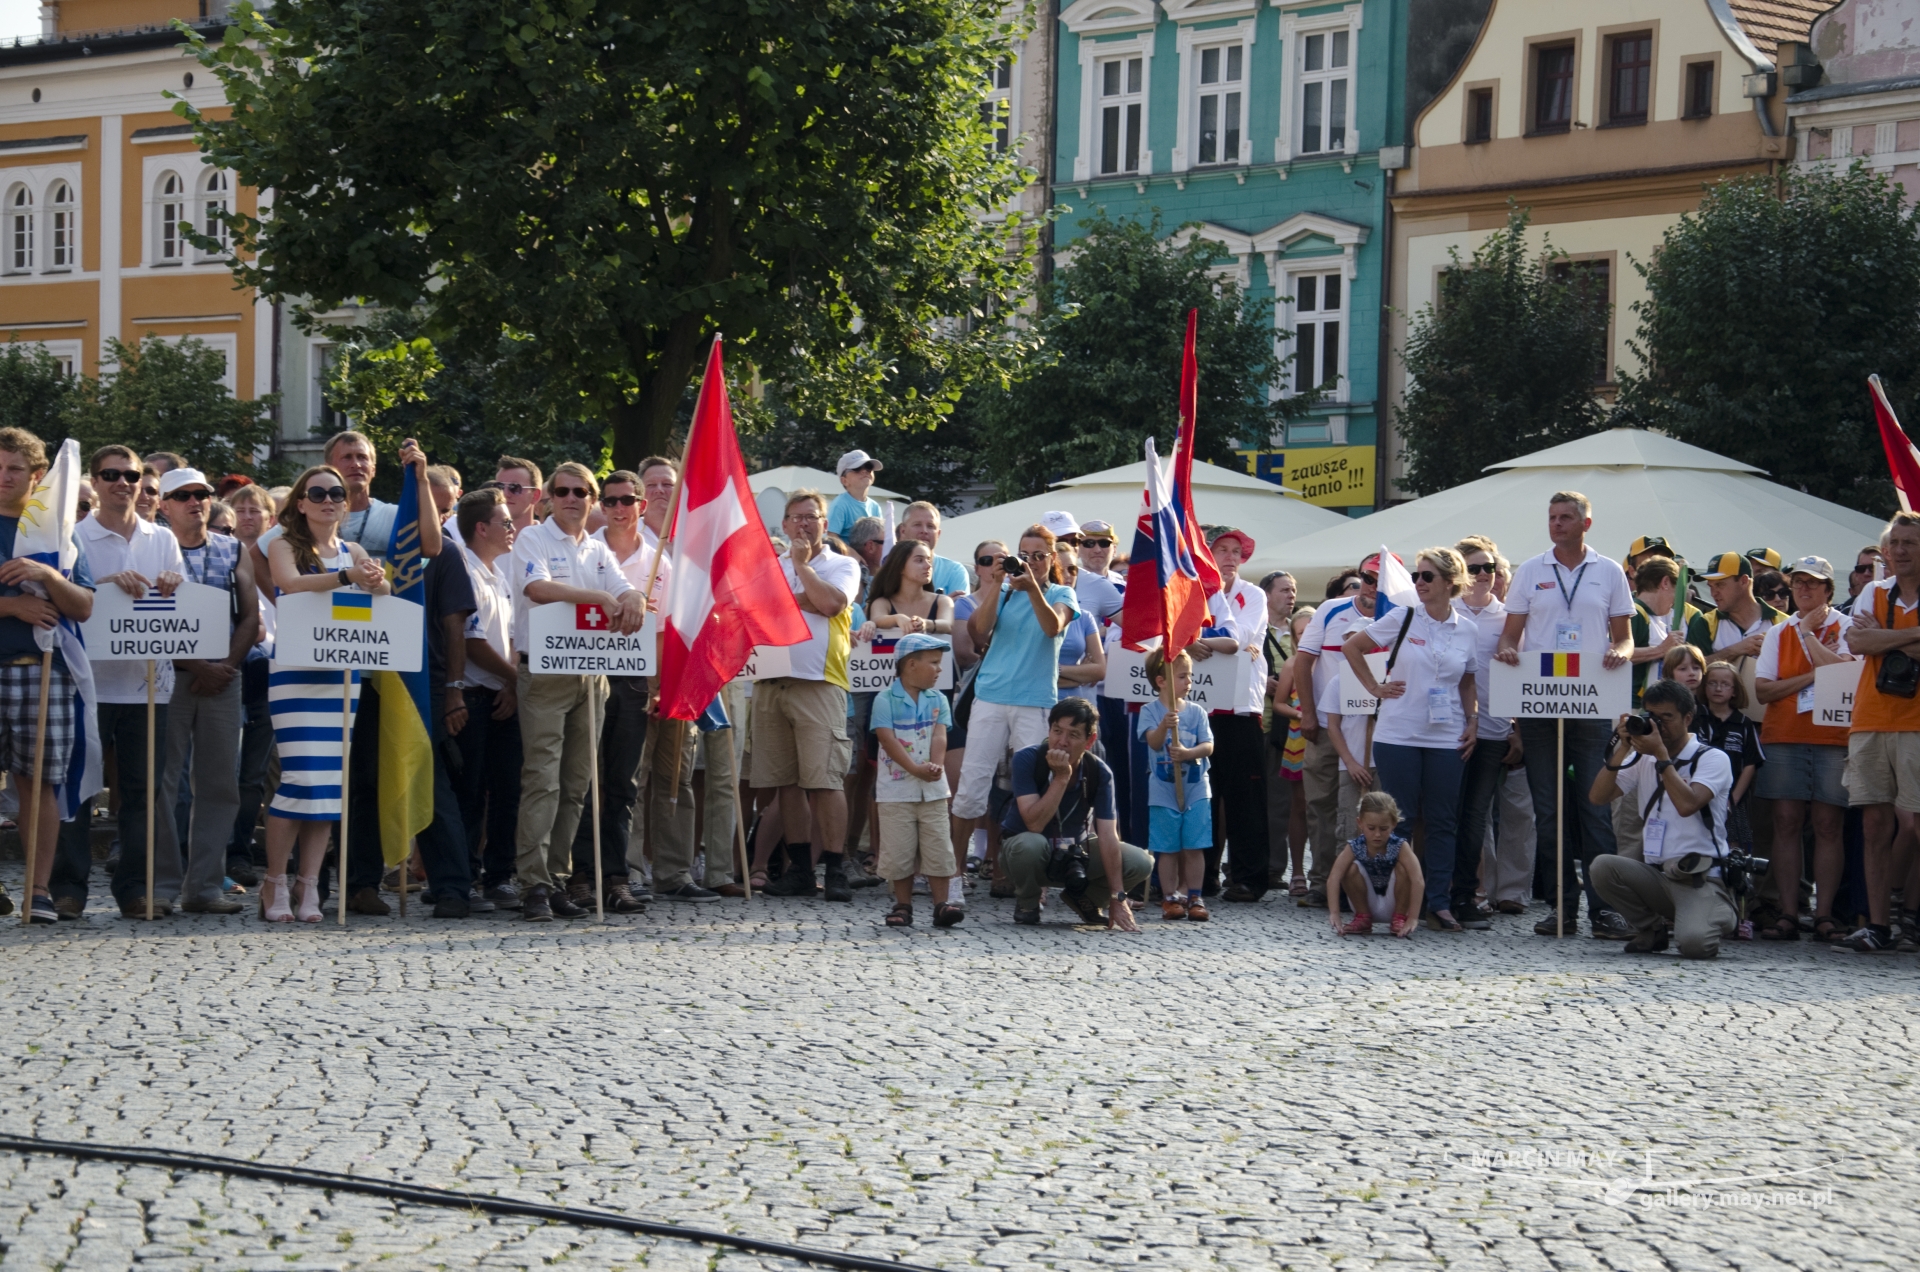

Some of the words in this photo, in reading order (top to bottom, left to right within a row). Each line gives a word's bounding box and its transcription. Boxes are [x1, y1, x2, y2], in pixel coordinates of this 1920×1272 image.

[1291, 458, 1348, 482] zawsze
[1302, 475, 1342, 499] tanio
[1348, 467, 1364, 490] !!!
[110, 619, 200, 633] URUGWAJ
[313, 627, 390, 645] UKRAINA
[111, 640, 198, 655] URUGUAY
[545, 636, 642, 651] SZWAJCARIA
[314, 648, 389, 665] UKRAINE
[541, 656, 646, 671] SWITZERLAND
[850, 659, 896, 671] SŁOW
[852, 675, 896, 688] SLOV
[1522, 683, 1599, 696] RUMUNIA
[1347, 699, 1376, 708] RUSS
[1842, 692, 1853, 705] H
[1521, 702, 1599, 715] ROMANIA
[1822, 709, 1853, 723] NET
